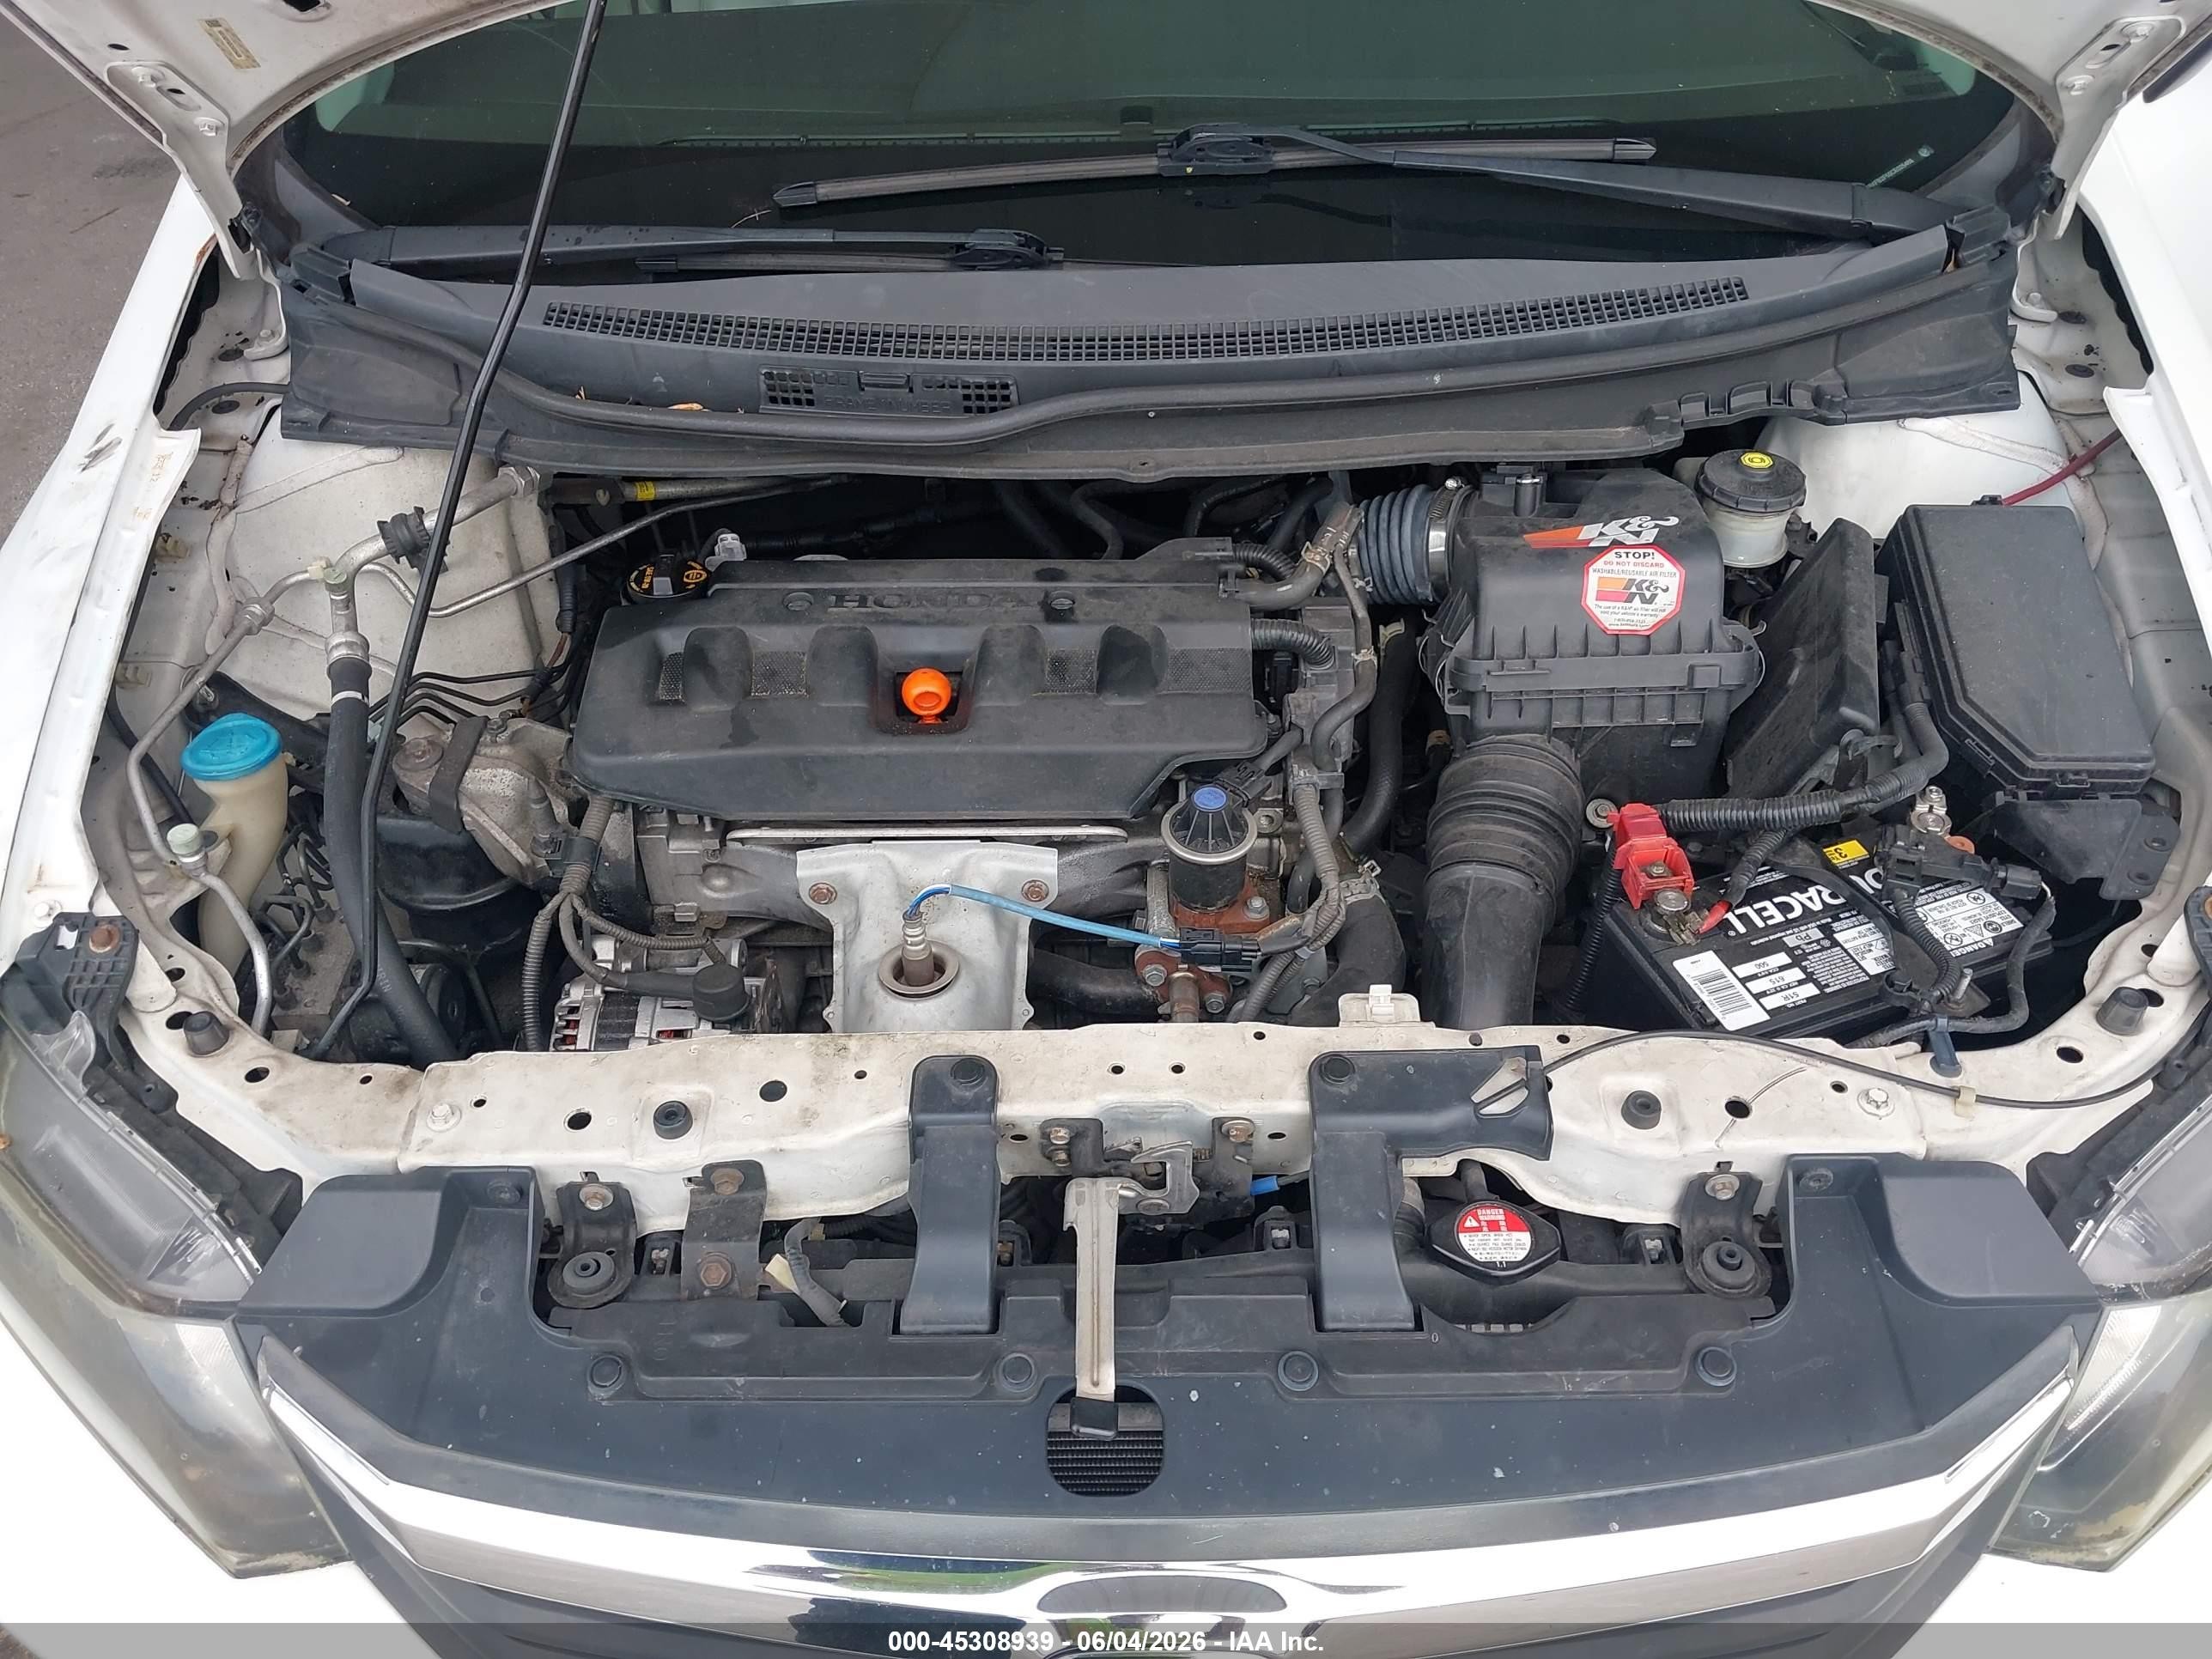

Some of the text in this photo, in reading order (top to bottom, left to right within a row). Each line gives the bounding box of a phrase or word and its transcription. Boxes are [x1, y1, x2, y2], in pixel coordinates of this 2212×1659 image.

[1577, 515, 1680, 547] K&N
[1614, 551, 1655, 560] STOP!
[1621, 577, 1669, 605] K&N
[827, 591, 1033, 612] HONDA
[1833, 847, 1848, 859] 3
[1795, 933, 1812, 943] Pb
[1754, 961, 1770, 969] 500
[1769, 975, 1785, 985] 615
[1781, 991, 1800, 1001] 51R
